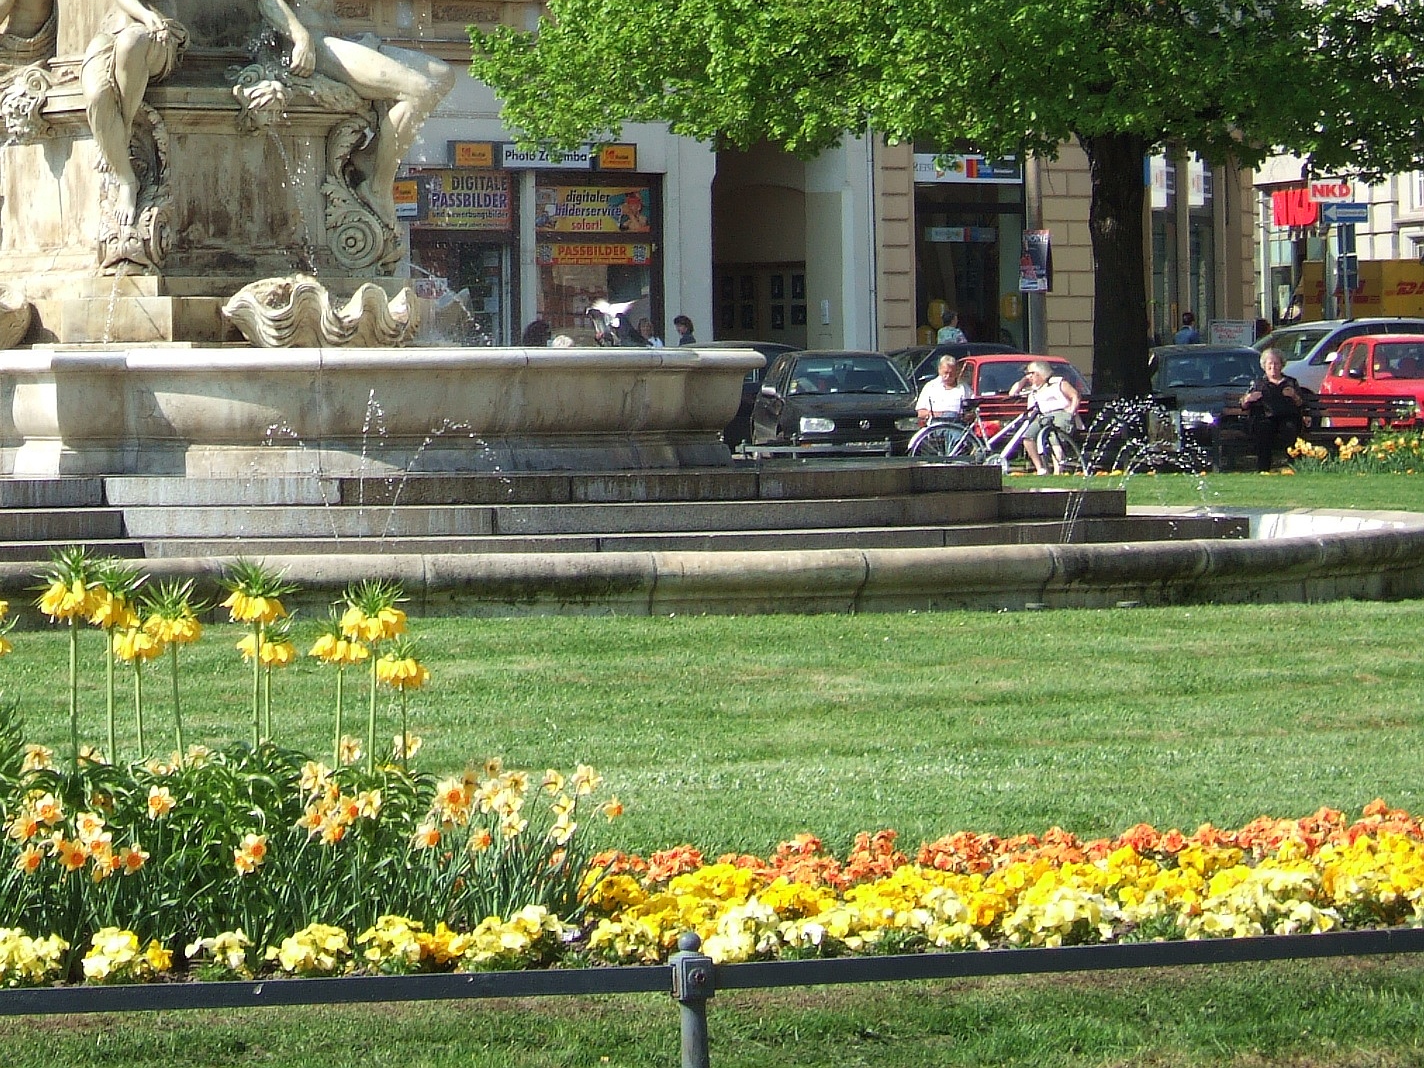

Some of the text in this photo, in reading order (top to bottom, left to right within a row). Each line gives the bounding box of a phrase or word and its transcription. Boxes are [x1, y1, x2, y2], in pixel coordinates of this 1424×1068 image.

[505, 149, 536, 161] Photo
[452, 175, 508, 191] DIGITALE
[566, 190, 610, 205] digitaler
[1311, 184, 1351, 198] NKD
[431, 192, 508, 208] PASSBILDER
[555, 203, 622, 217] bilderservice
[571, 218, 603, 231] sofort!
[558, 245, 627, 256] PASSBILDER
